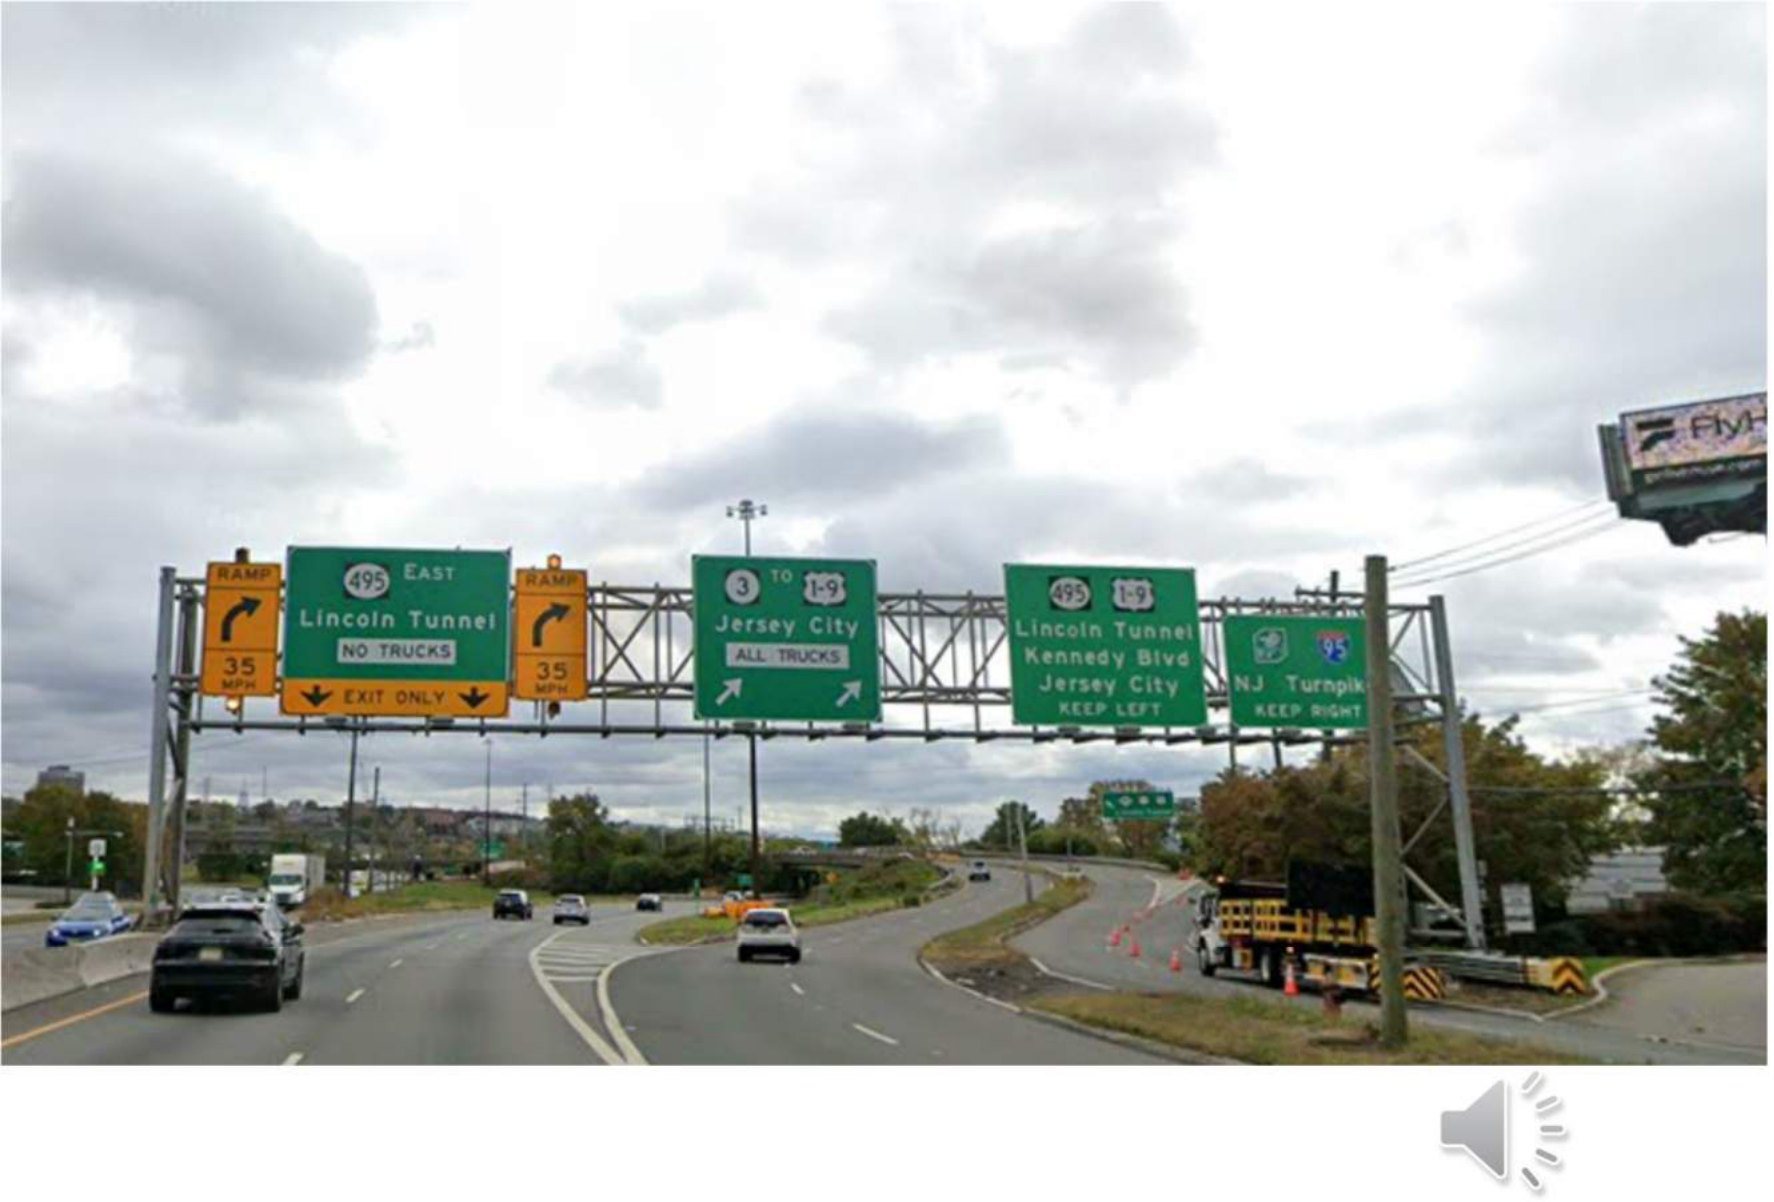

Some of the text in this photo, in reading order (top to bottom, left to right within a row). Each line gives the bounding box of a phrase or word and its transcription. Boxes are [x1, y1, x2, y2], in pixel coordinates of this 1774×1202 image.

[217, 566, 271, 581] RAMP
[349, 570, 386, 591] 495
[526, 573, 578, 587] RAMP
[736, 569, 839, 598] 3 TO 1-9
[1053, 584, 1147, 603] 495 1-9
[299, 609, 497, 630] Lincoln Tunnel
[715, 614, 859, 640] Jersey City
[1014, 619, 1193, 641] Lincoln Tunnel
[341, 643, 452, 660] NO TRUCKS
[735, 648, 841, 665] ALL TRUCKS
[1023, 646, 1191, 670] Kennedy Blvd
[1322, 638, 1346, 660] 95
[222, 657, 256, 676] 35
[536, 662, 568, 682] 35
[221, 678, 257, 690] MPH
[534, 683, 568, 696] MPH
[1038, 674, 1179, 699] Jersey City
[1233, 675, 1371, 698] NJ Turnpik
[343, 689, 445, 705] EXIT ONLY
[1058, 702, 1163, 717] KEEP LEFT
[1255, 704, 1362, 719] KEEP RIGHT
